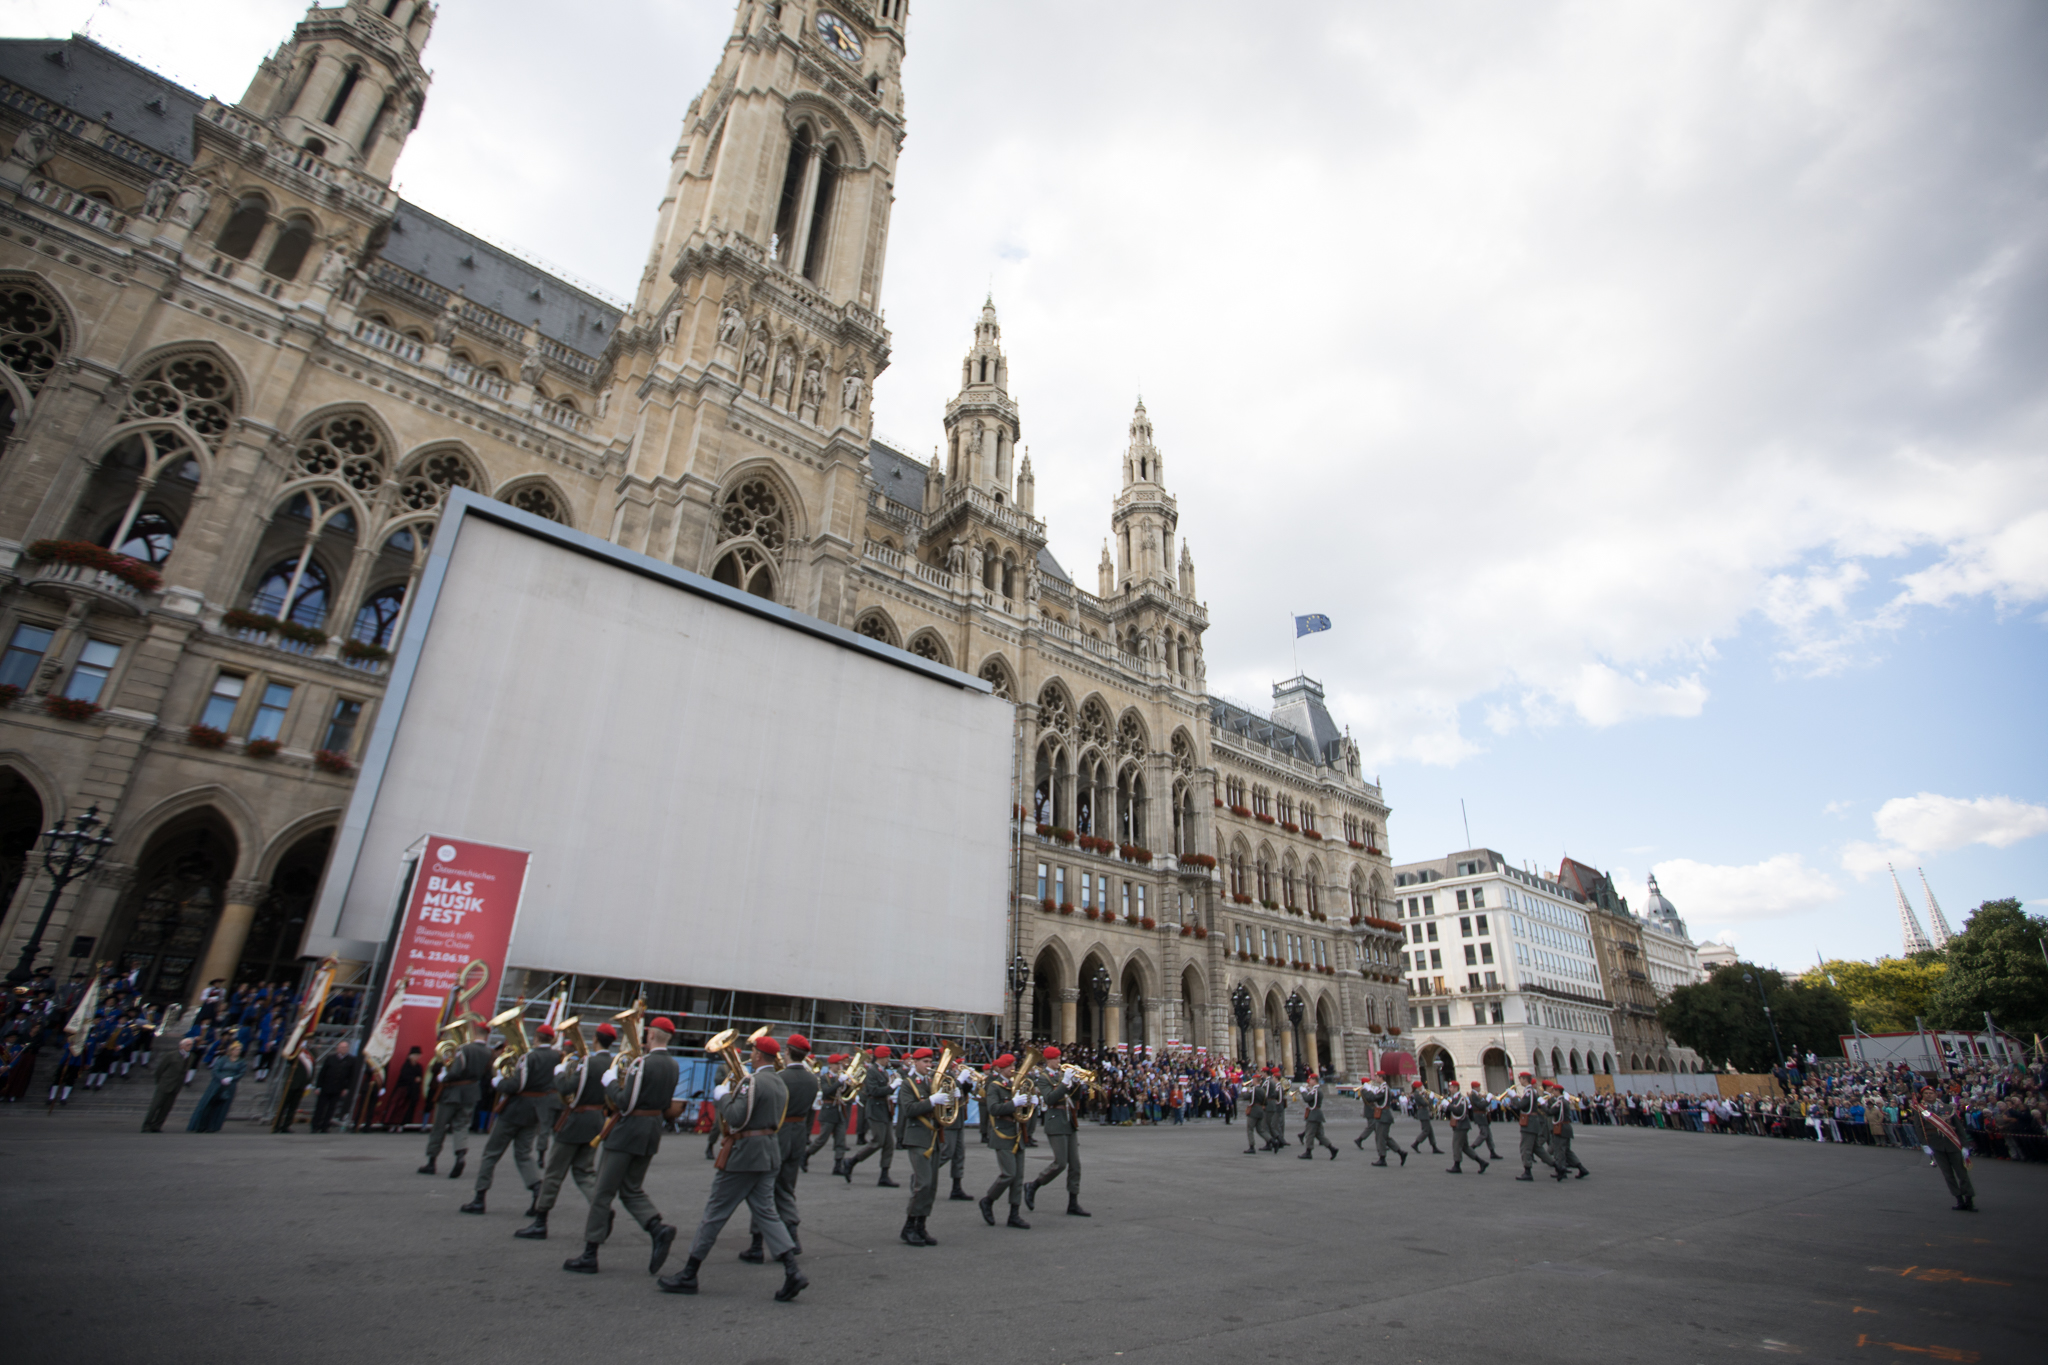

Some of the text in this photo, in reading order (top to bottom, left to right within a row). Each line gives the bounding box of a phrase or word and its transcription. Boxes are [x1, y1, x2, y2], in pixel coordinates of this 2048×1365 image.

[427, 876, 475, 895] BLAS
[423, 892, 484, 912] MUSIK
[419, 906, 466, 924] FEST
